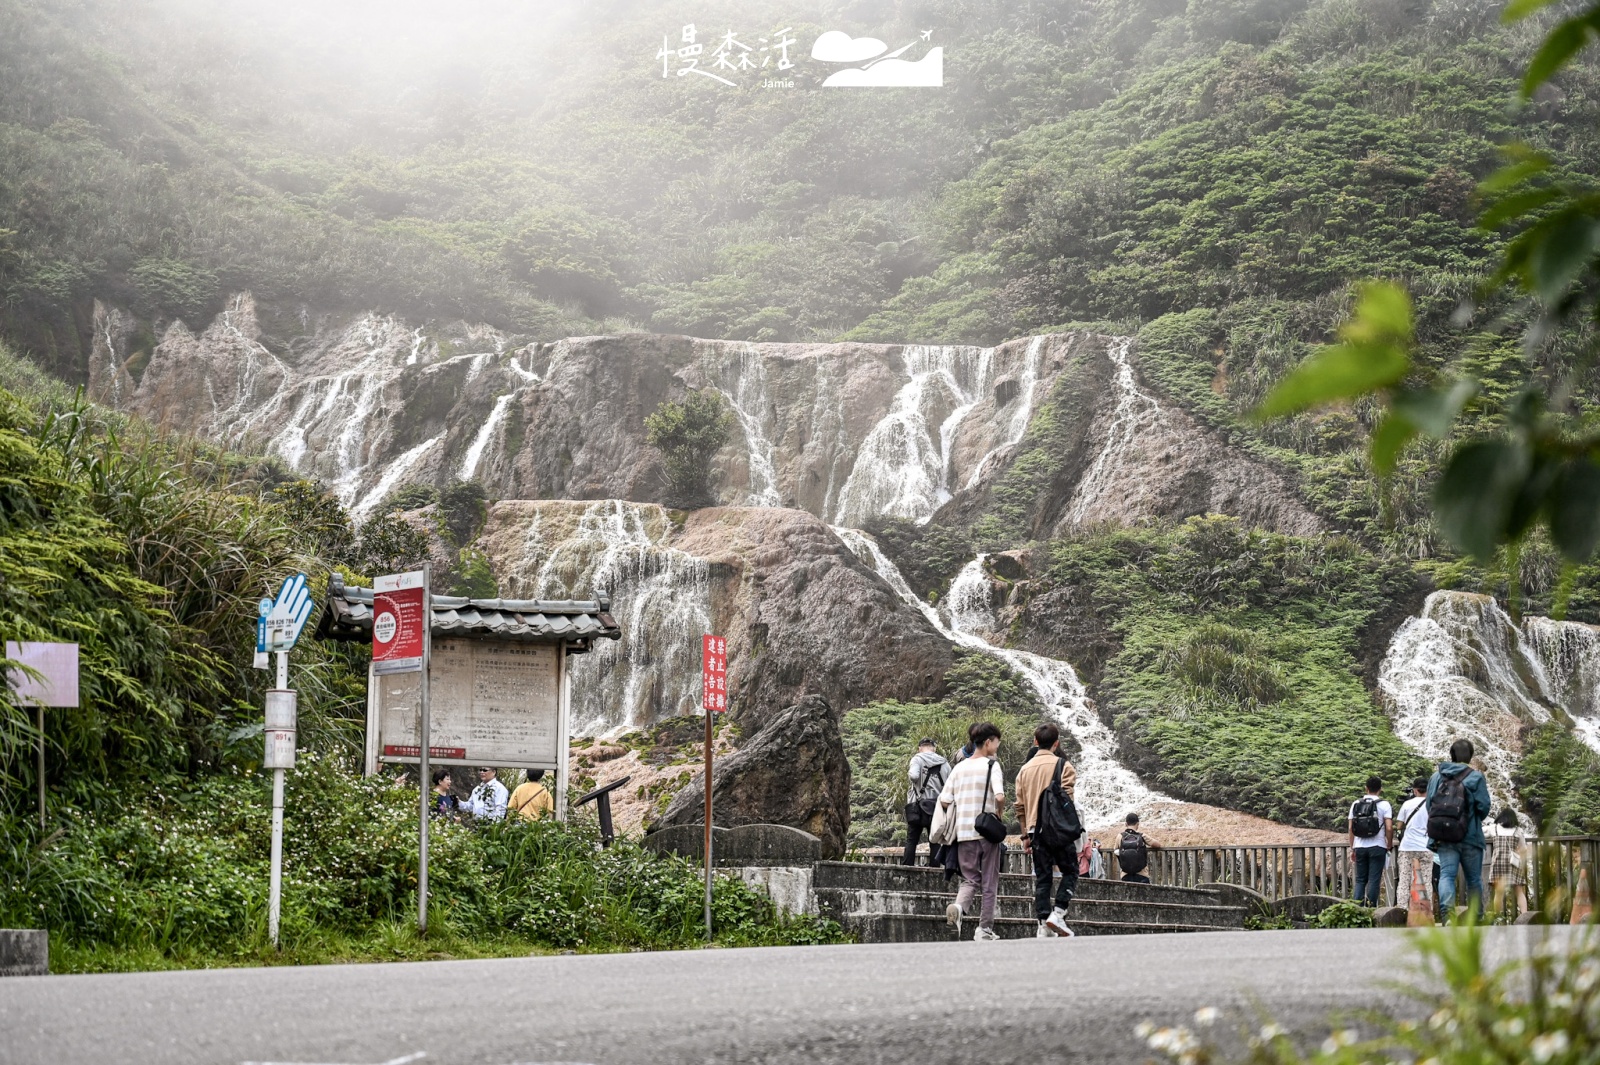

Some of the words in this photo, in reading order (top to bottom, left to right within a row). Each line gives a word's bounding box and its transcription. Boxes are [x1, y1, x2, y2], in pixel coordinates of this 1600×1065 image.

[708, 637, 716, 707] 違者告發
[716, 639, 725, 709] 禁止設攤
[275, 733, 287, 741] 891
